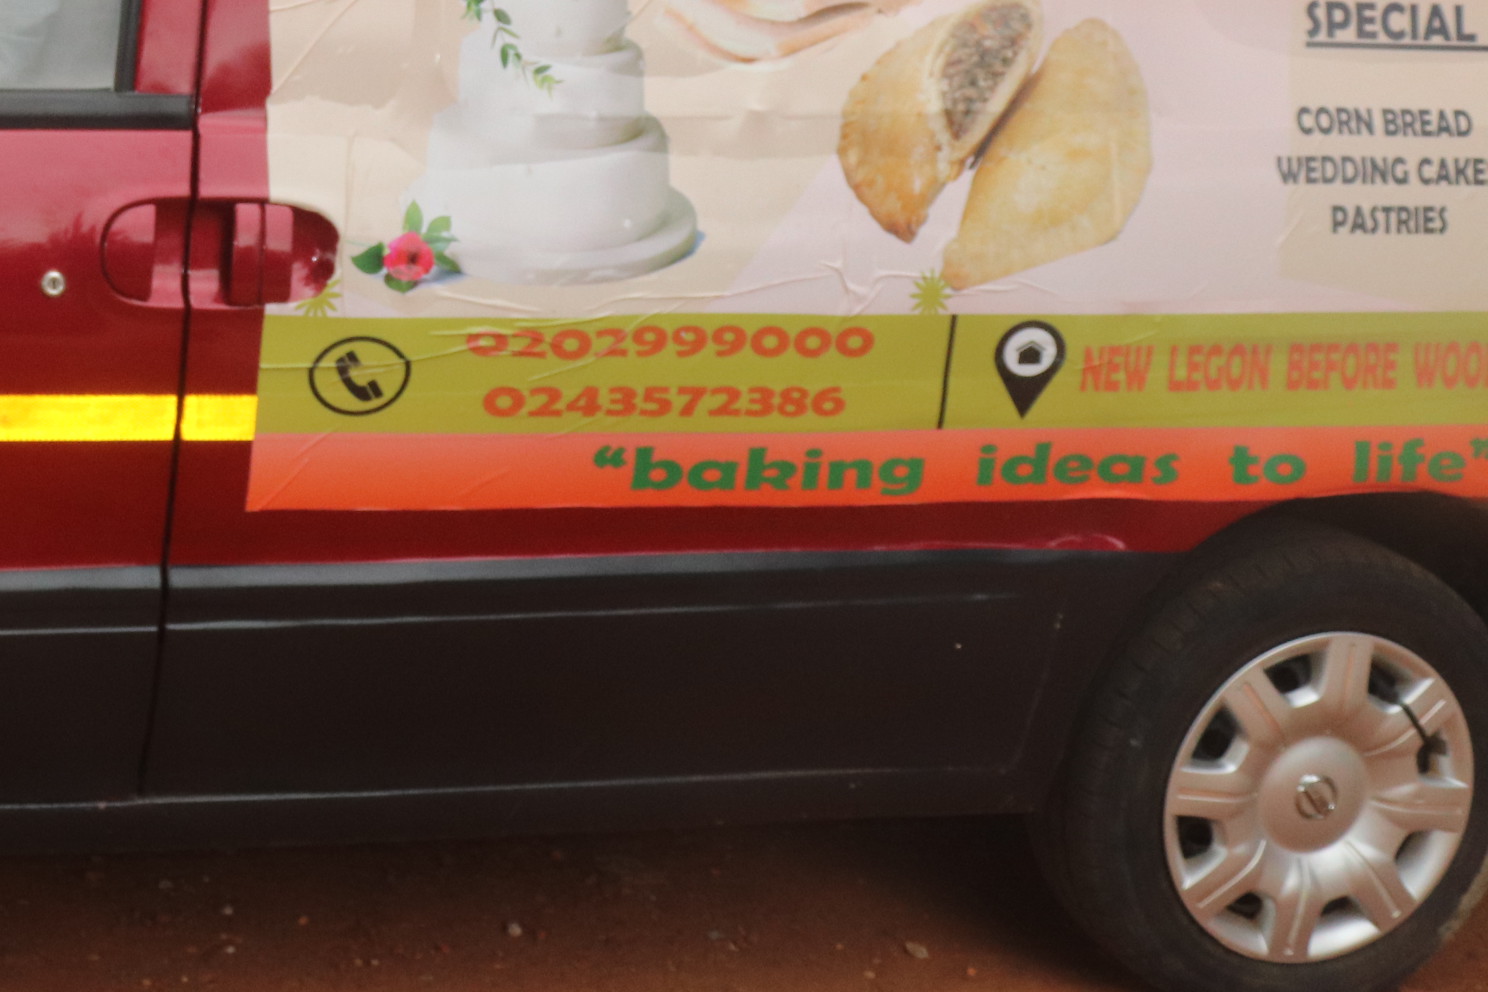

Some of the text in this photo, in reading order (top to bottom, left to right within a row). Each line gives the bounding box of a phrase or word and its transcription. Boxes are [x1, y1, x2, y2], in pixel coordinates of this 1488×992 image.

[1306, 0, 1478, 43] SPECIAL
[1297, 107, 1473, 137] CORN BREAD
[1276, 156, 1488, 186] WEDDING CAKE
[1331, 205, 1449, 235] PASTRIES
[466, 324, 876, 361] 0202999000
[1079, 340, 1488, 392] NEW LEGON BEFORE WOO
[482, 385, 846, 419] 0243572386
[975, 441, 1181, 487] ideas
[1228, 444, 1308, 486] to
